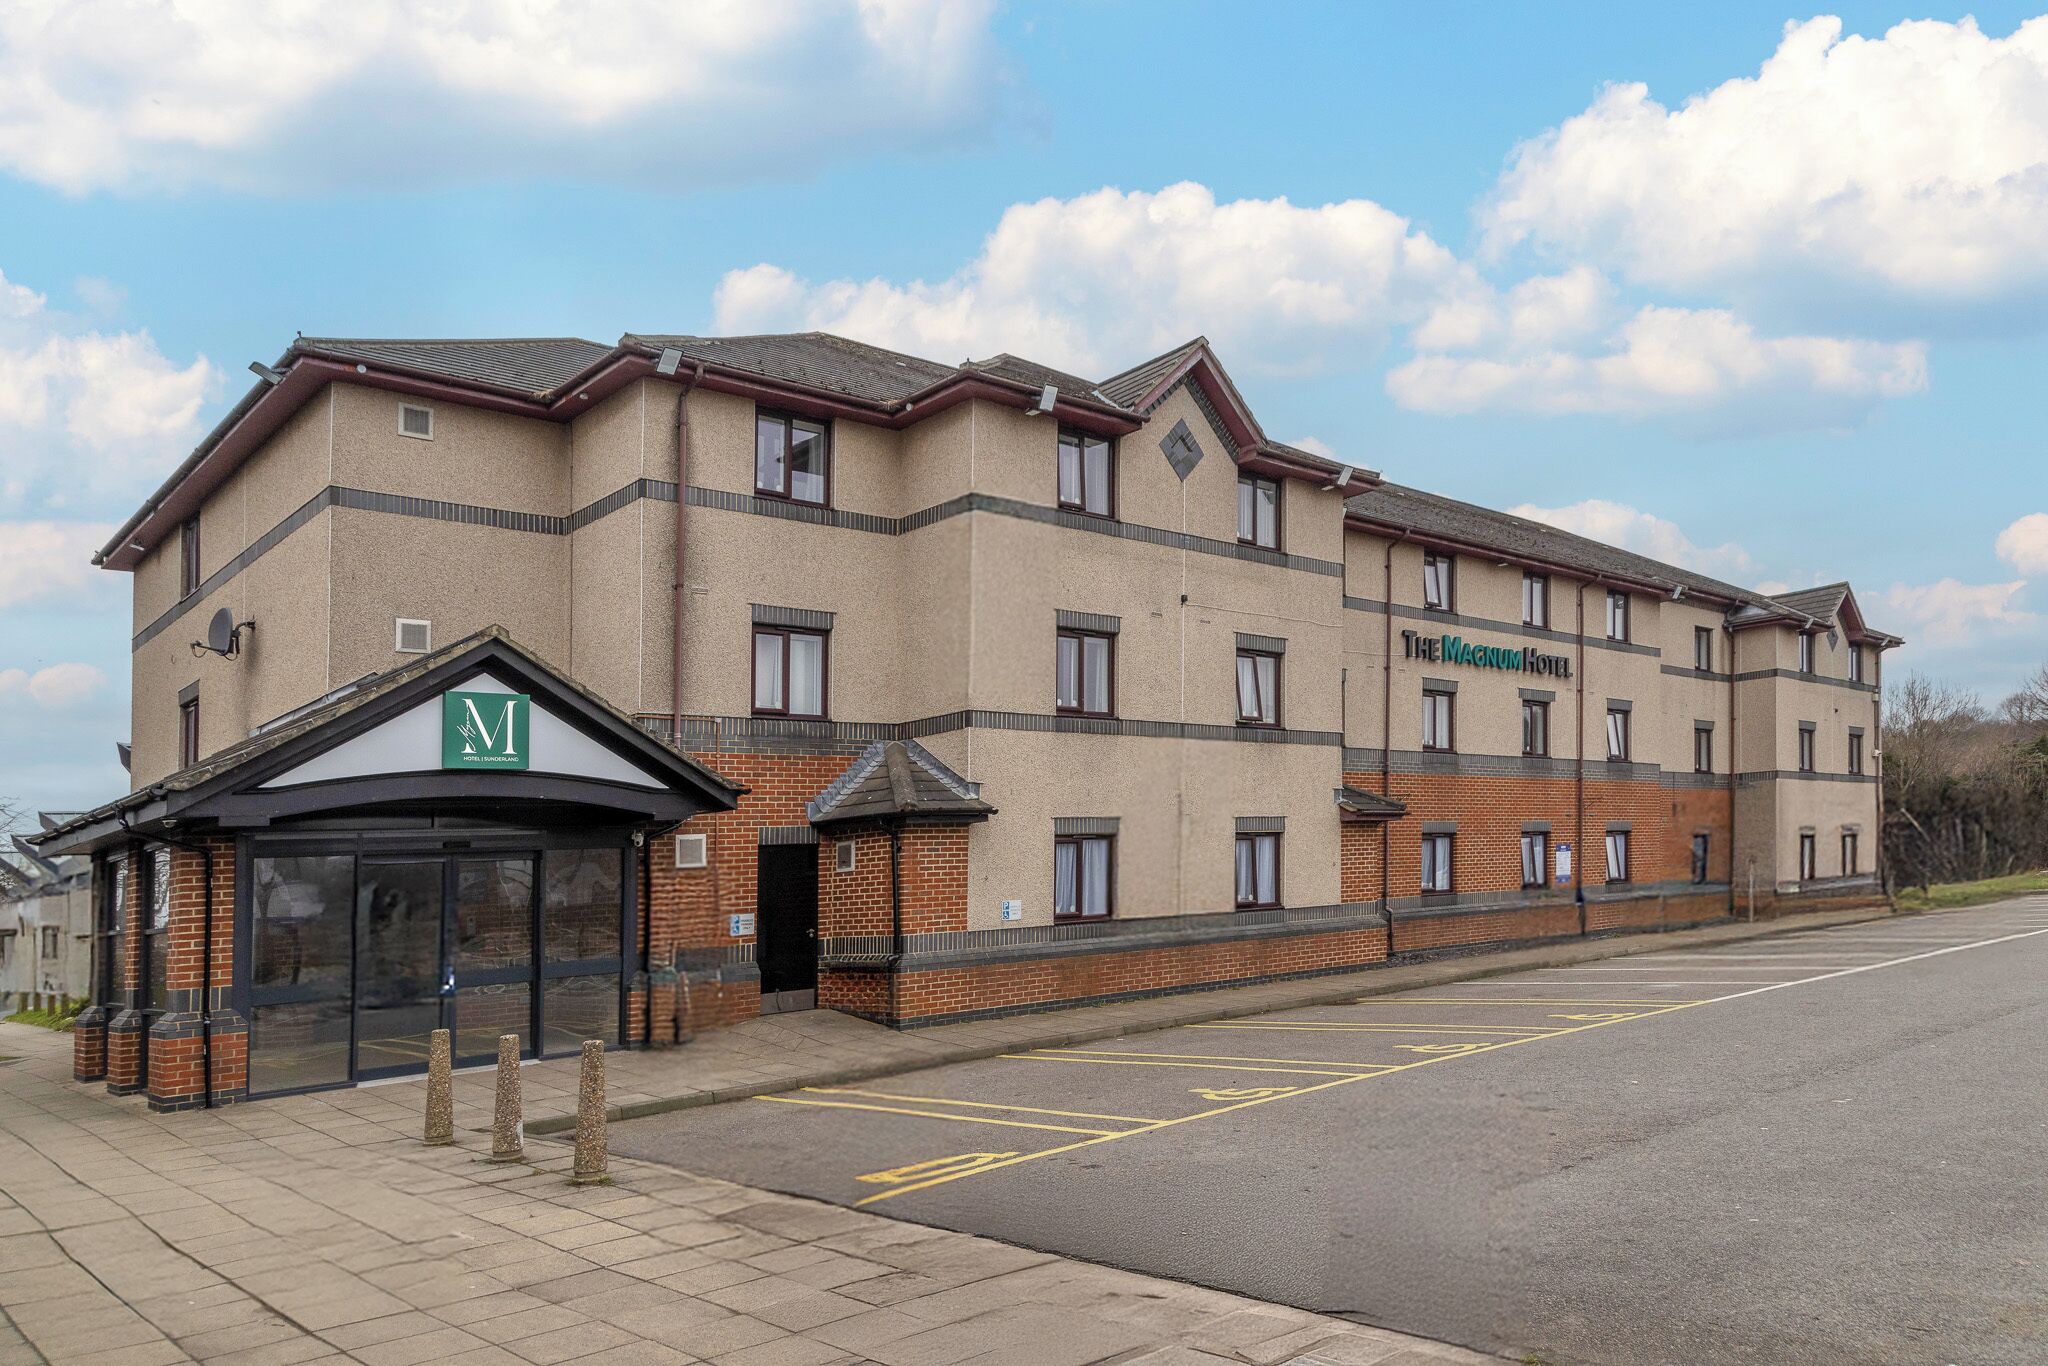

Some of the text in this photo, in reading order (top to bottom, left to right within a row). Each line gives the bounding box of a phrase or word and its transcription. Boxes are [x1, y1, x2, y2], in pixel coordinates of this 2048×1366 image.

[1402, 630, 1573, 678] THE MAGNUM HOTEL
[461, 698, 518, 754] M
